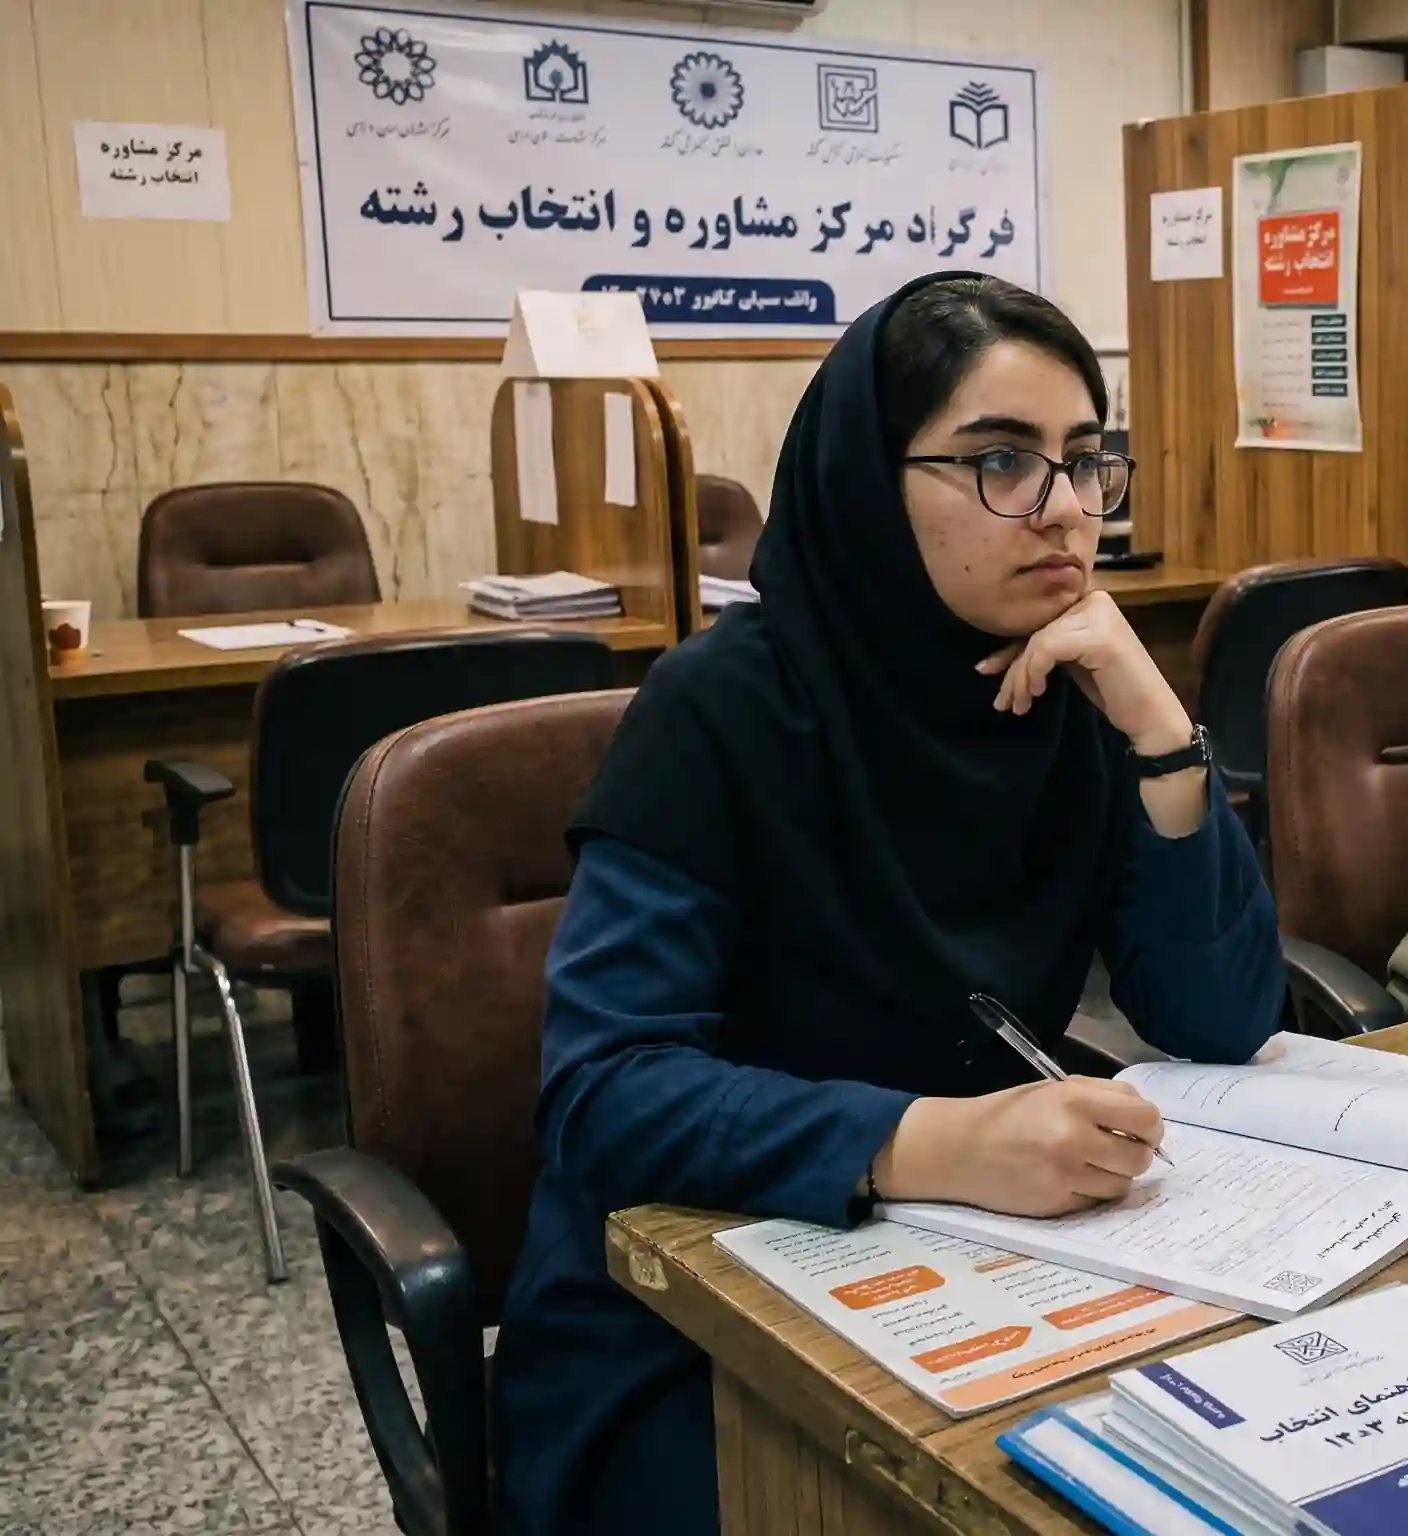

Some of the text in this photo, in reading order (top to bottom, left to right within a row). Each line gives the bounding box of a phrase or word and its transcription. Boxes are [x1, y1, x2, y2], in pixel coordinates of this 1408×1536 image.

[100, 137, 203, 163] مرکز مشاوره
[109, 167, 199, 186] انتخاب رشته
[359, 180, 465, 242] رشته
[478, 183, 615, 242] انتخاب
[630, 208, 651, 248] و
[665, 194, 798, 250] مشاوره
[809, 200, 895, 254] مرکز
[1263, 219, 1337, 250] مرکز مشاوره
[1263, 248, 1335, 277] انتخاب رشته
[1260, 1405, 1340, 1444] انتخاب
